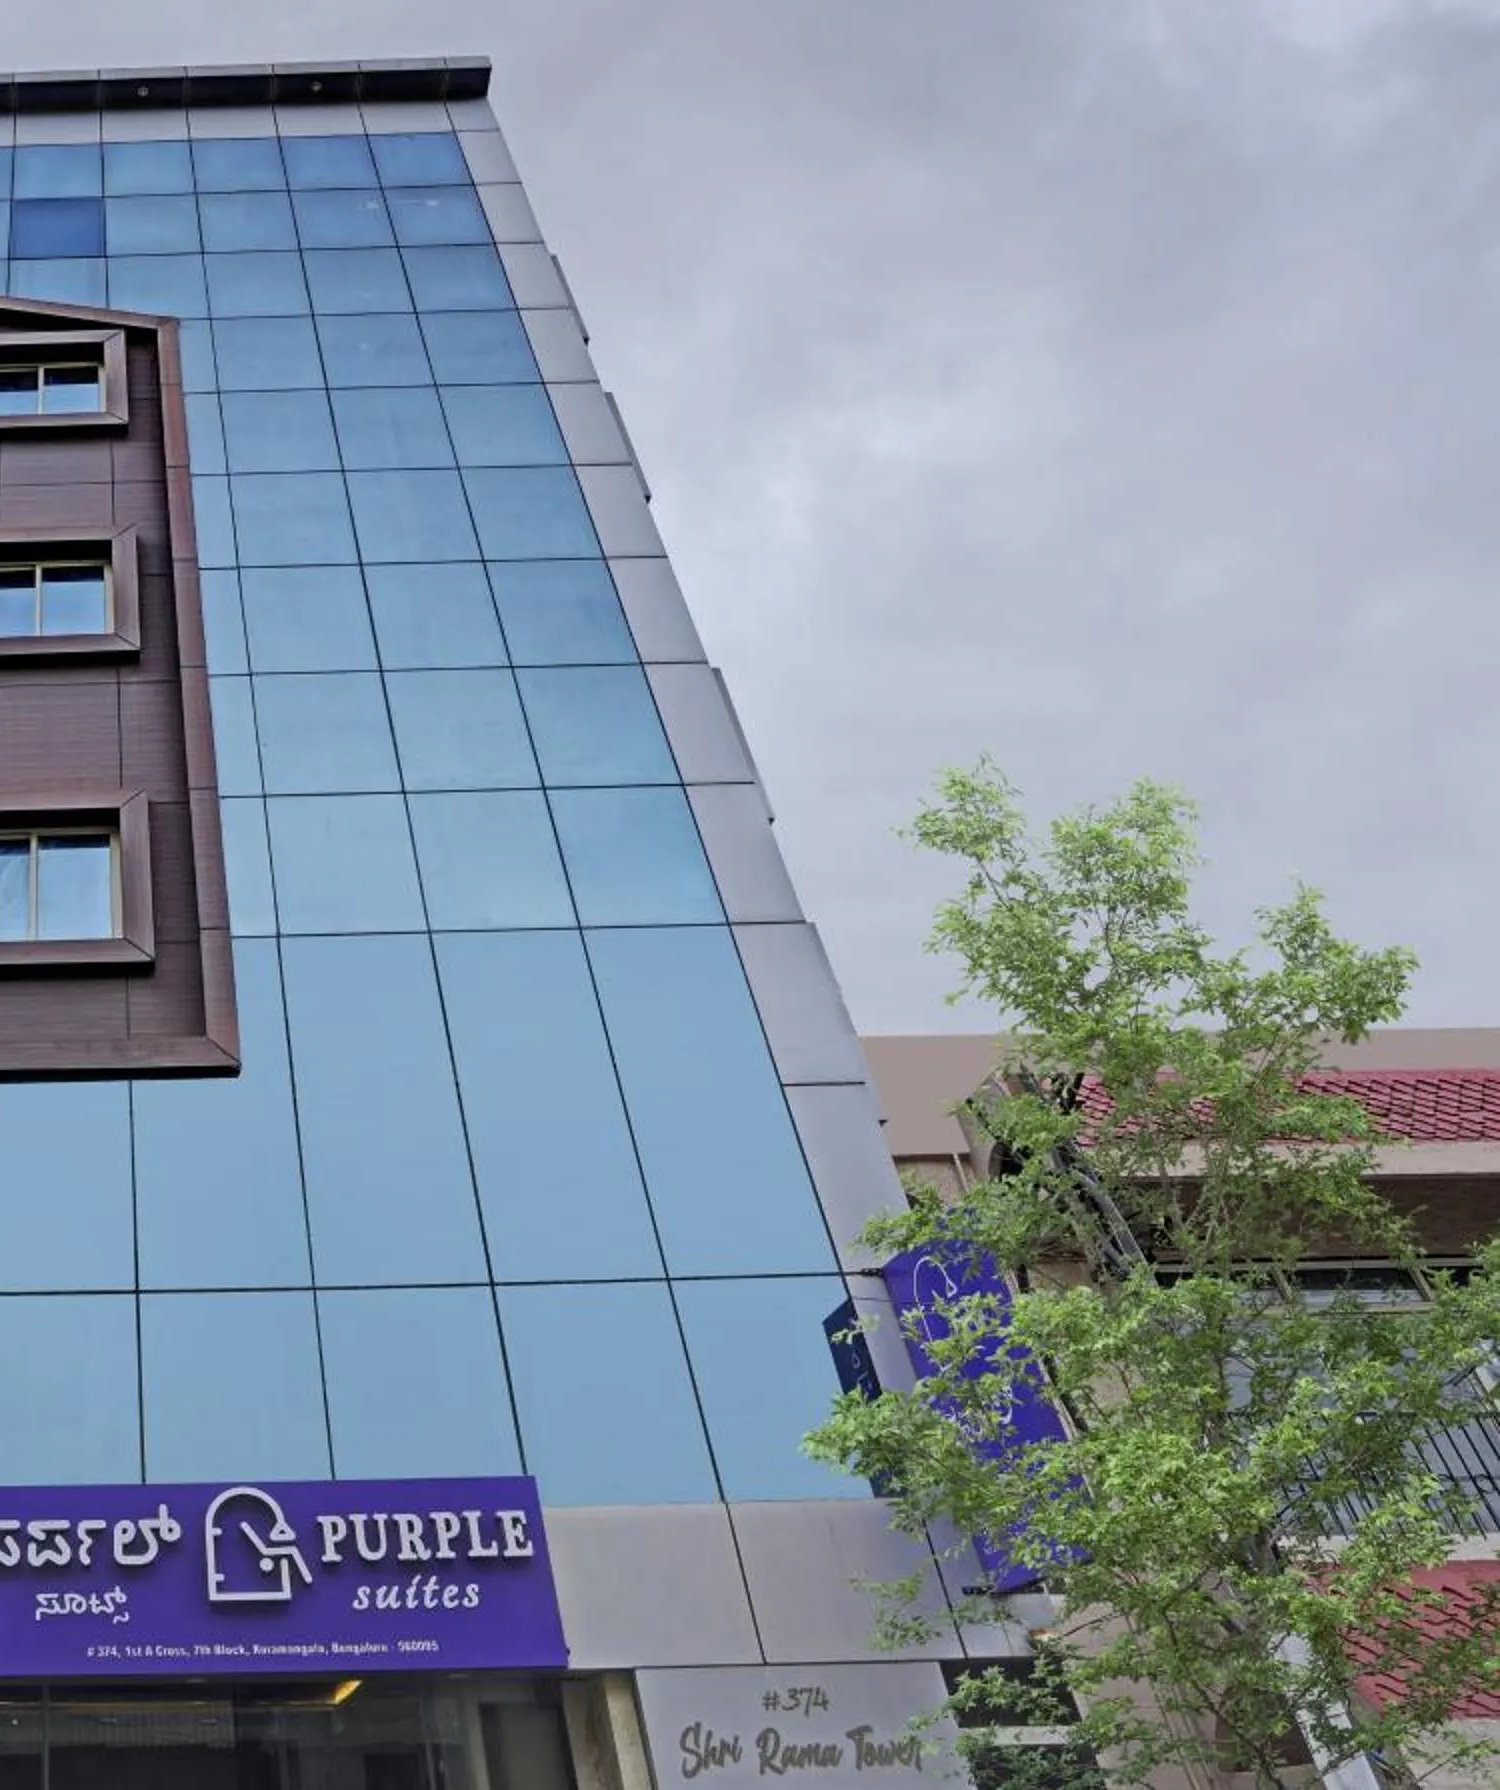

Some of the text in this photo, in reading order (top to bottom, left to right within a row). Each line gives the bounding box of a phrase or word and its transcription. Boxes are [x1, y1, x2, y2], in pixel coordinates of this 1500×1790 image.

[316, 1510, 534, 1563] PURPLE
[352, 1573, 480, 1610] suites
[97, 1645, 121, 1658] 374,
[125, 1645, 143, 1657] 1st
[155, 1644, 191, 1658] Cross,
[213, 1643, 250, 1657] Block,
[252, 1642, 329, 1656] Koramangala,
[762, 1687, 830, 1717] #374
[679, 1721, 923, 1779] Shri Rama Tower
